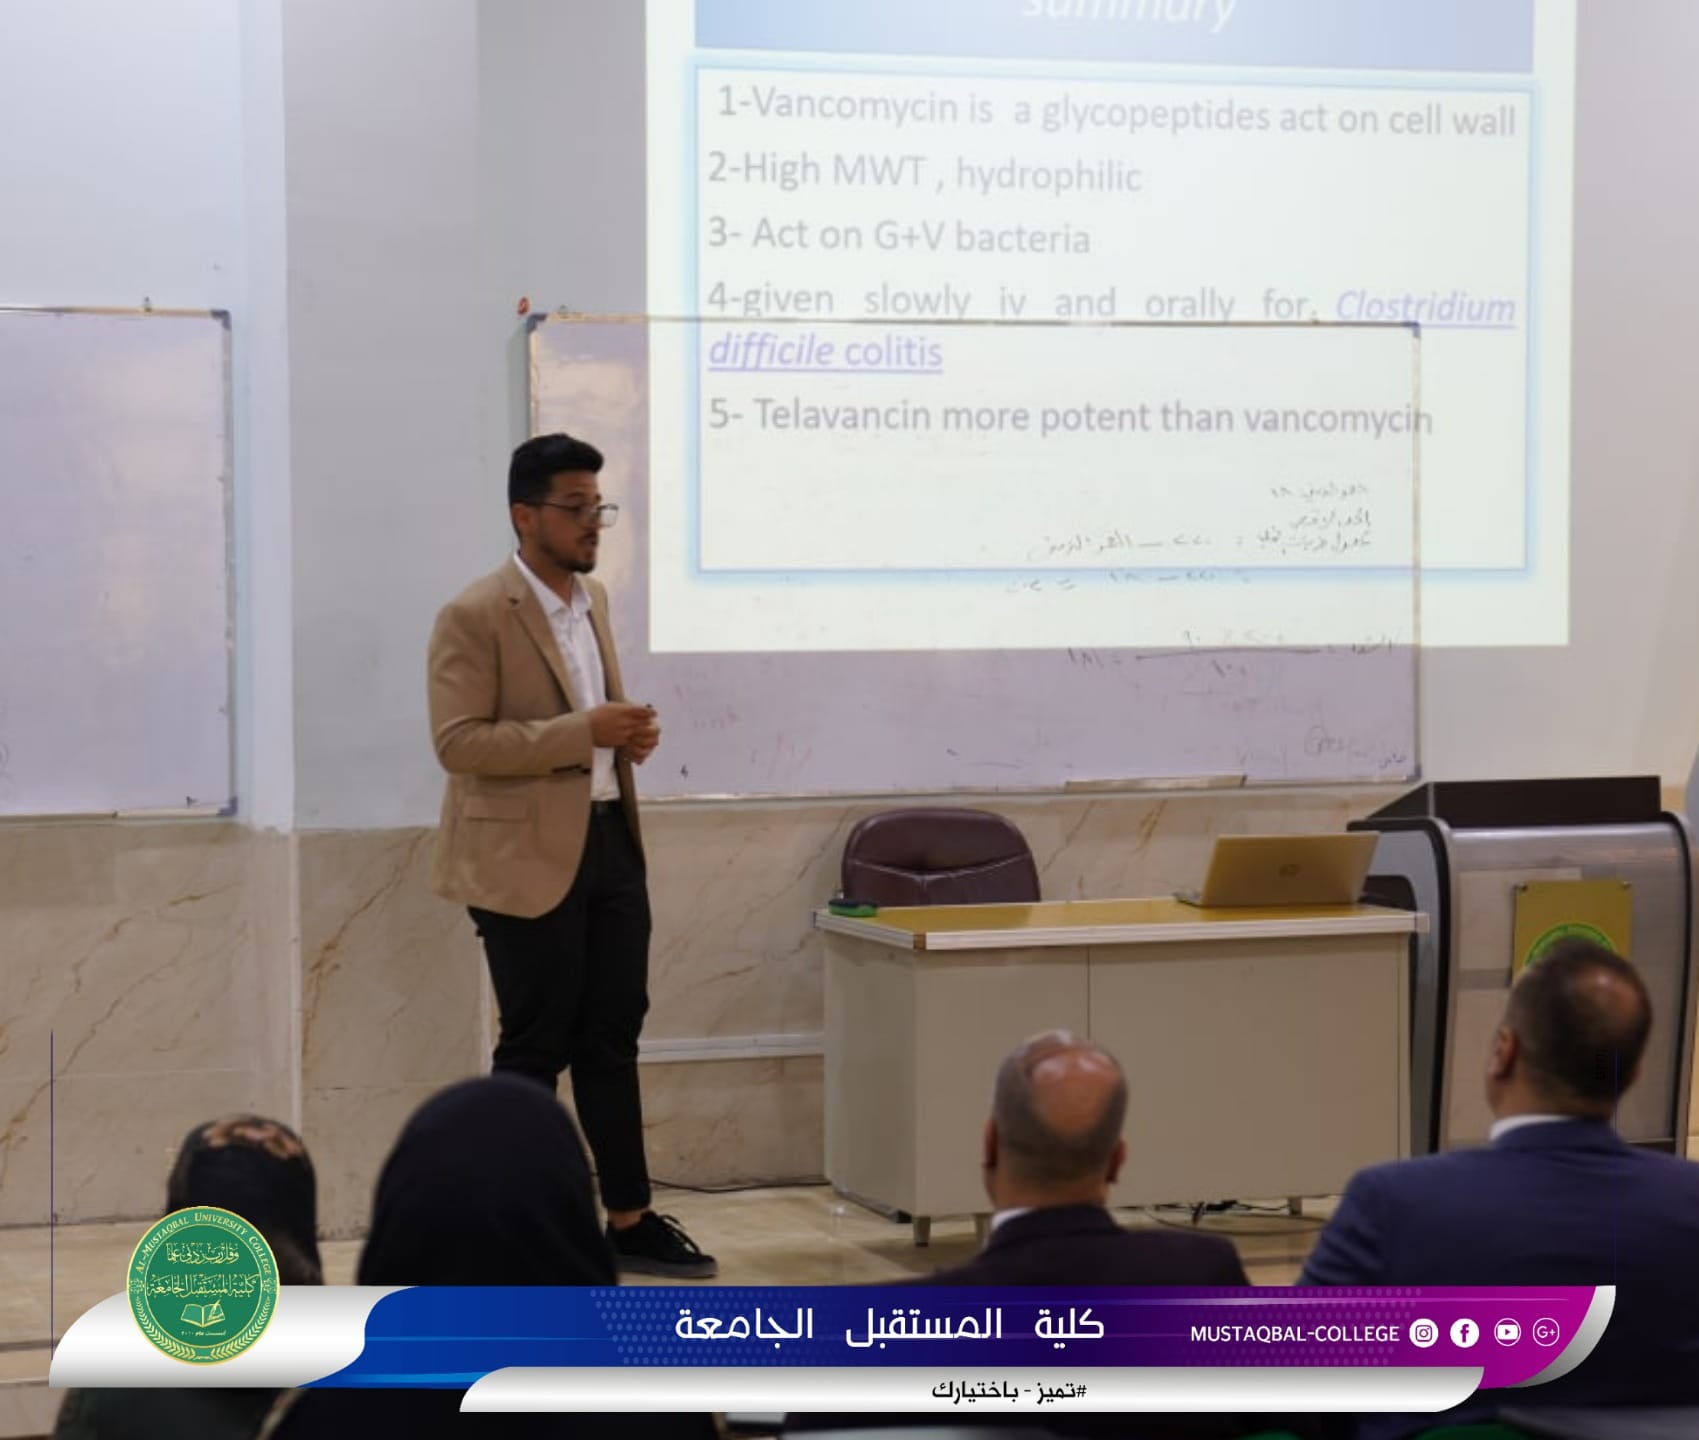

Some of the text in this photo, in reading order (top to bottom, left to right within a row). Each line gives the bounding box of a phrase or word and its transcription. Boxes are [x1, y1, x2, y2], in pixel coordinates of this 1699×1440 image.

[717, 84, 1517, 137] 1-Vancomycin is a glycopeptides act on cell wall
[708, 150, 821, 191] 2-High
[833, 154, 928, 188] MWT
[956, 157, 1143, 198] hydrophilic
[708, 217, 1091, 254] 3- Act on G+V bacteria
[707, 280, 834, 318] 4-given
[863, 281, 972, 318] slowly
[998, 287, 1027, 316] iv
[1054, 287, 1116, 319] and
[1144, 286, 1237, 320] orally
[1336, 289, 1517, 323] Clostridium
[708, 331, 945, 370] difficile colitis
[708, 395, 1434, 439] 5- Telavancin more potent than vancomycin
